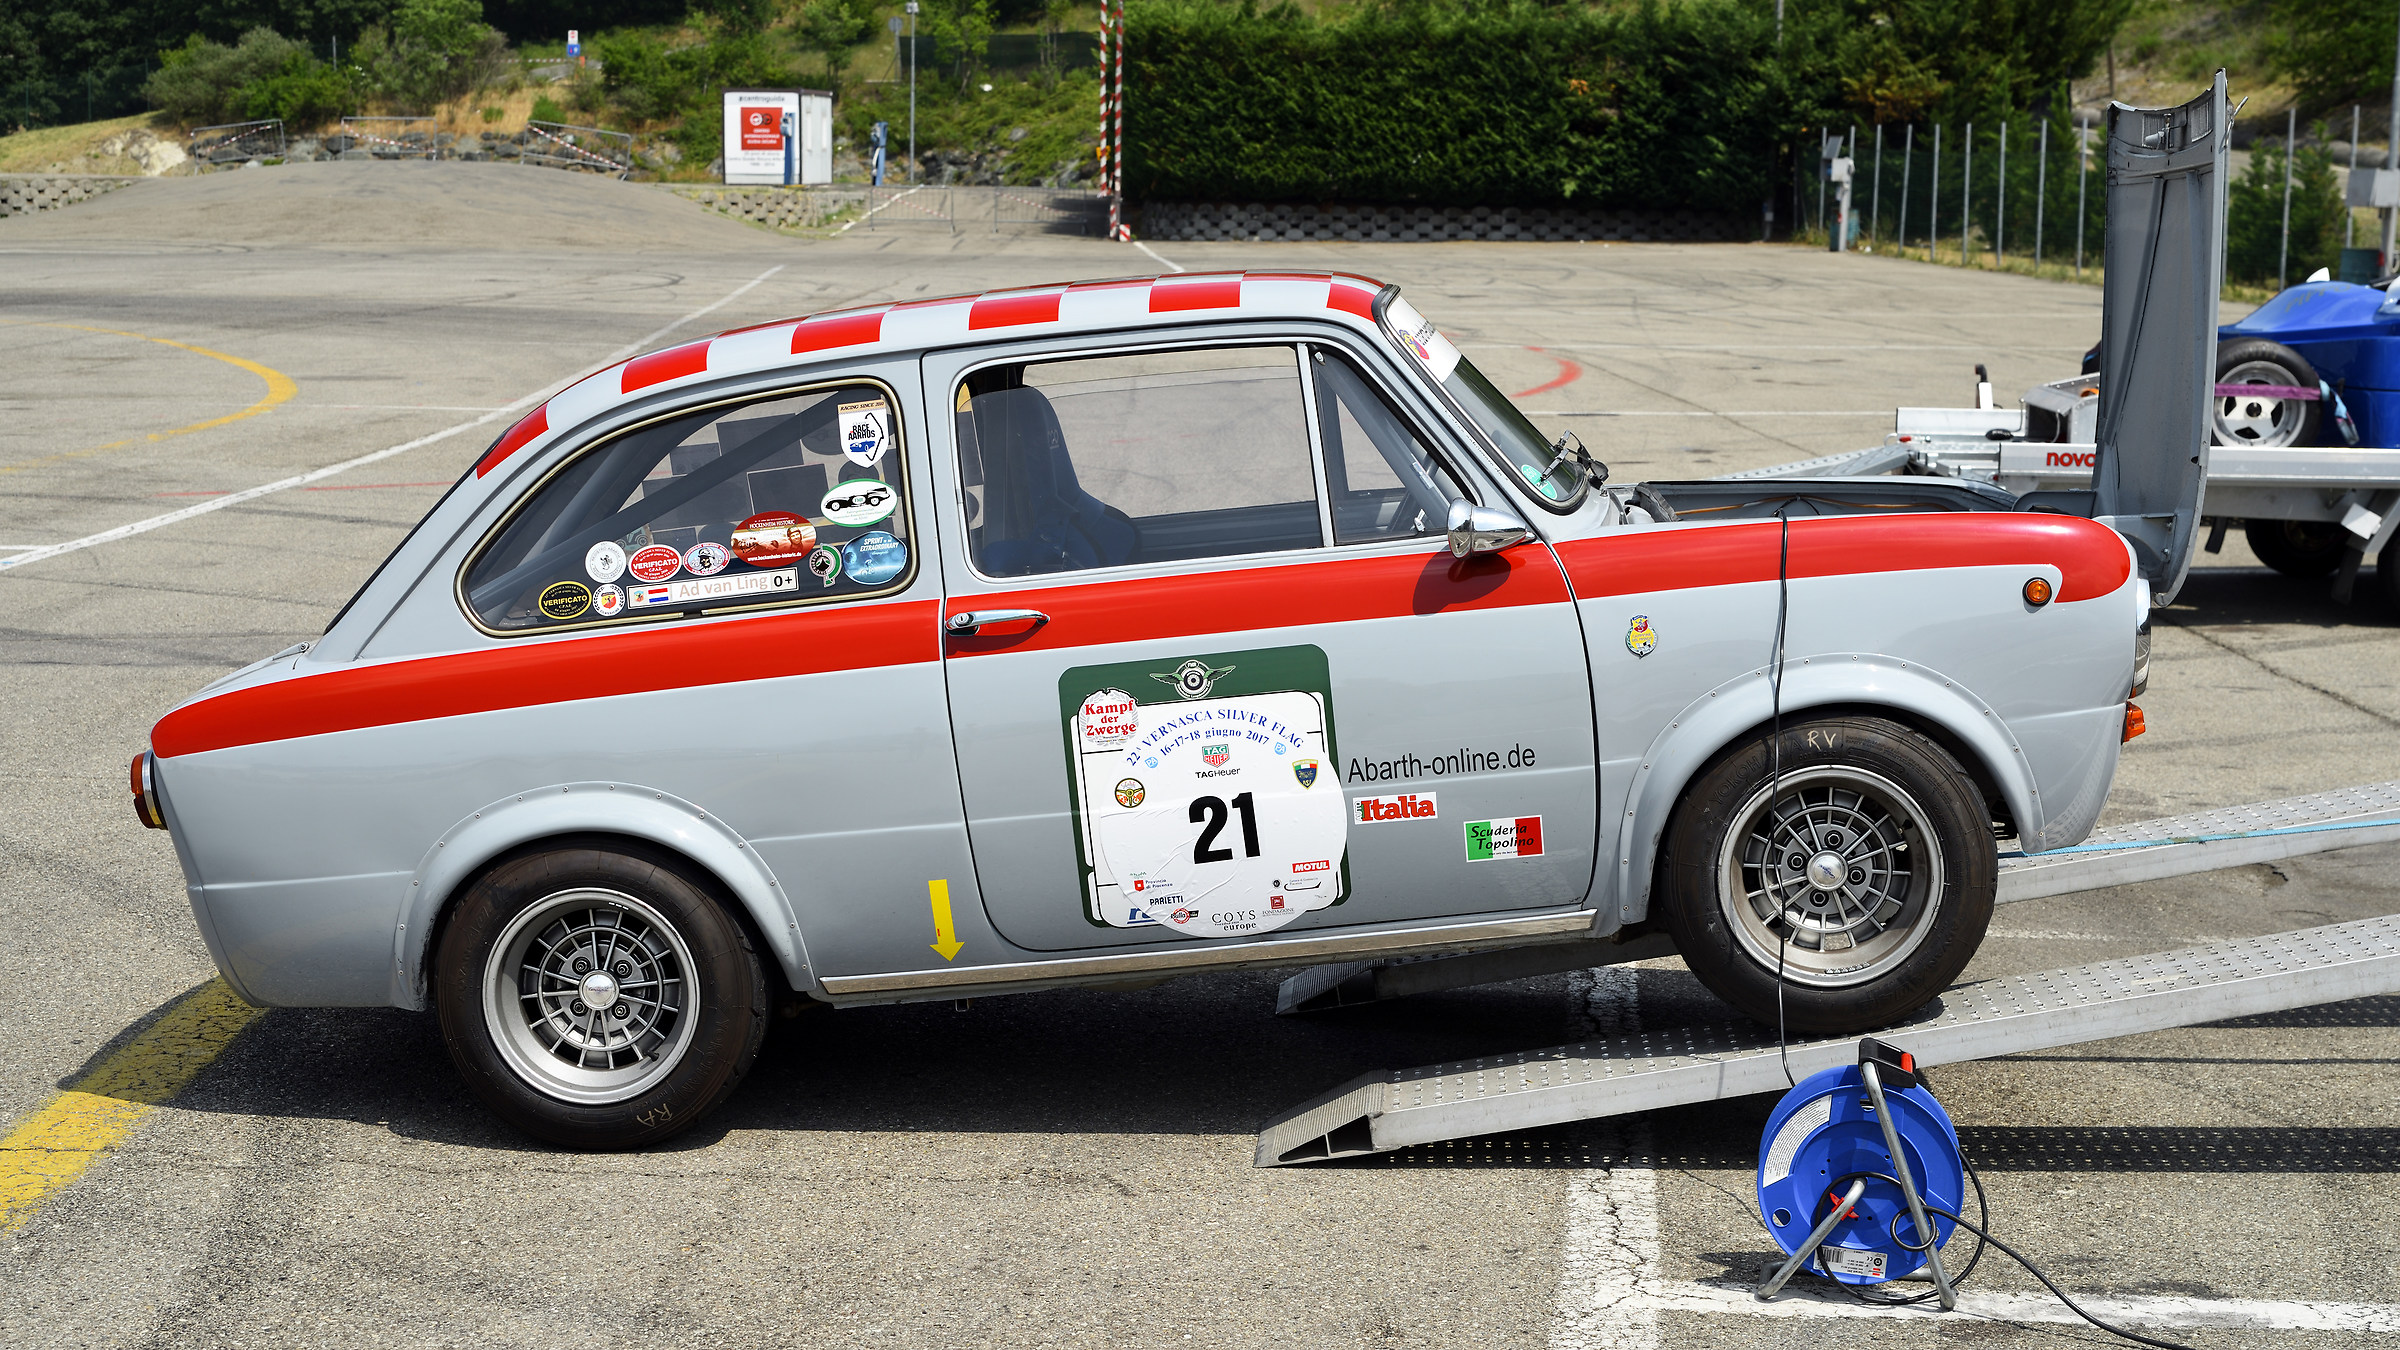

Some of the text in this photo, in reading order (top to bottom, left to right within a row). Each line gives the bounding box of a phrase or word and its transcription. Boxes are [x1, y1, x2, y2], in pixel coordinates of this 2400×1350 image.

[848, 430, 876, 440] AARHUS
[852, 424, 869, 433] RACE
[860, 542, 899, 552] EXTRAORDINARY
[863, 537, 884, 545] SPRINT
[632, 558, 678, 570] VERIFICATO
[679, 583, 700, 598] Ad
[704, 581, 732, 595] van
[737, 575, 768, 590] Ling
[543, 594, 588, 607] VERIFICATO
[1085, 700, 1134, 715] Kampf
[1100, 715, 1119, 724] der
[1086, 723, 1137, 736] Zwerge
[1142, 710, 1213, 747] VERNASCA
[1217, 709, 1268, 727] SILVER
[1271, 721, 1304, 748] FLAG
[1160, 727, 1270, 756] 16-17-18 giugno 2017
[1807, 730, 1836, 751] RV
[1204, 746, 1228, 754] TAG
[1204, 754, 1229, 767] HEUER
[1348, 742, 1536, 783] Abarth-online.de
[1361, 794, 1436, 821] Italia
[1188, 791, 1261, 865] 21
[1470, 824, 1527, 838] Scuderia
[1476, 836, 1534, 851] Topolino
[1295, 861, 1328, 872] MOTUL
[1149, 895, 1184, 906] PARIETTI
[1212, 909, 1256, 923] COYS
[1223, 922, 1257, 931] europe
[636, 1102, 673, 1127] RA
